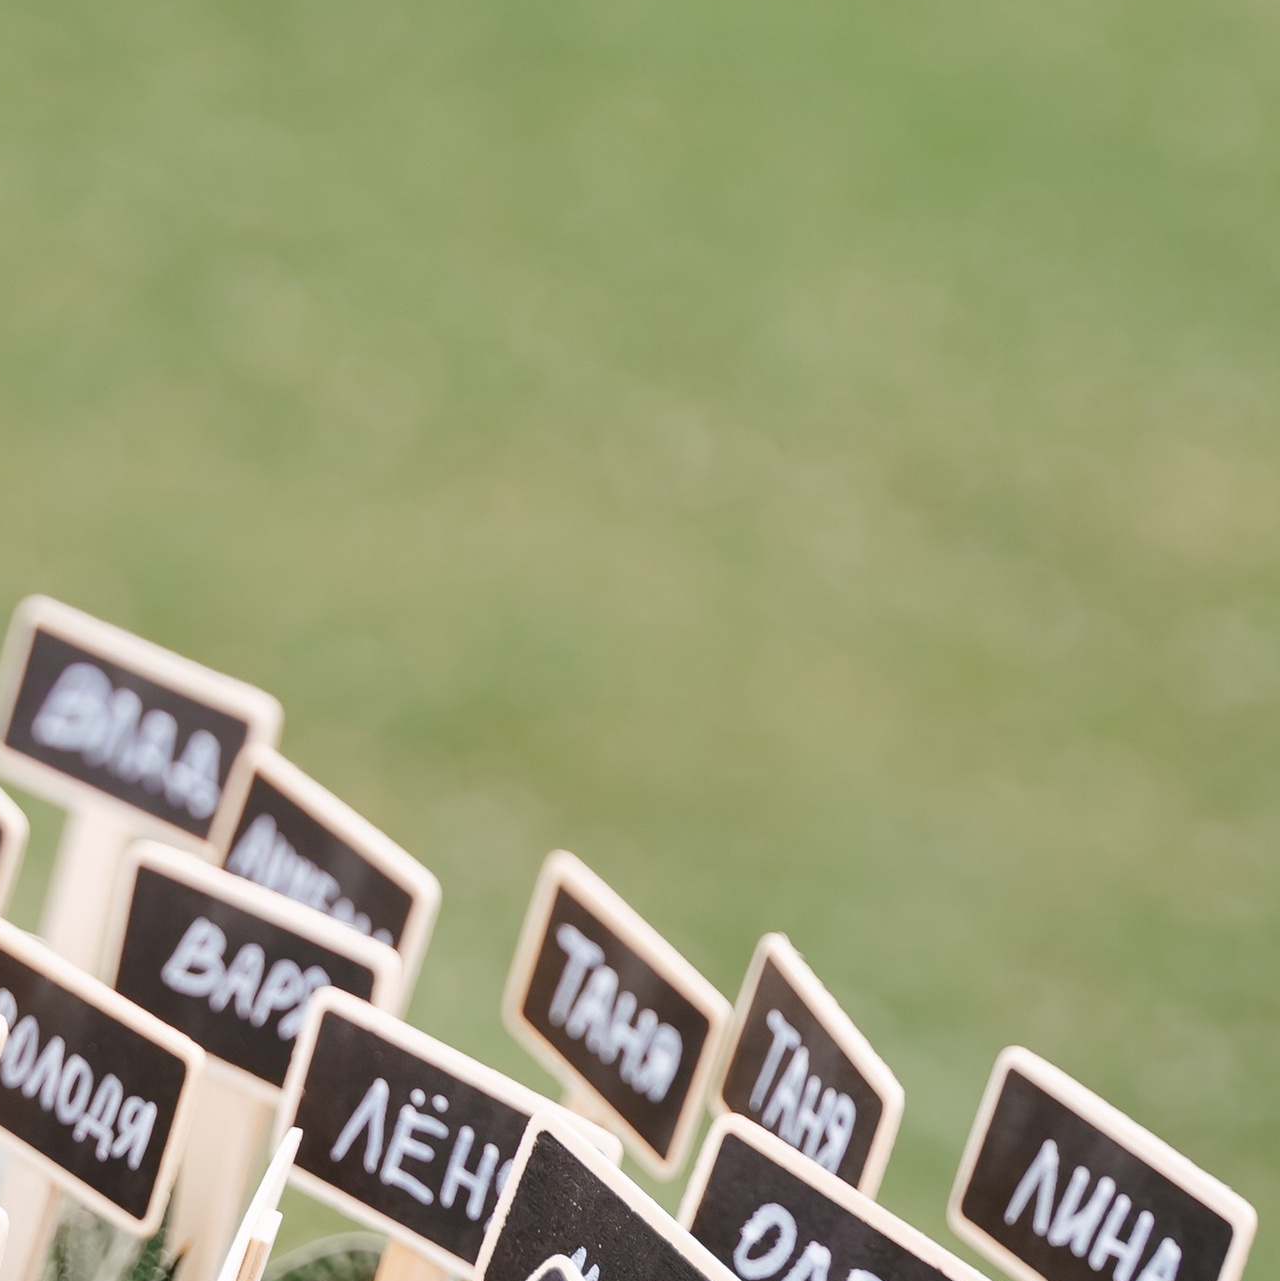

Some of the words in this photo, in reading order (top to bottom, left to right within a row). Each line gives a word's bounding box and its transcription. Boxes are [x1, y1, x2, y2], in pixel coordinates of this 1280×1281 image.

[548, 922, 683, 1104] ТАНЯ
[748, 1008, 857, 1175] ТАНЯ
[330, 1077, 512, 1232] ЛЁН
